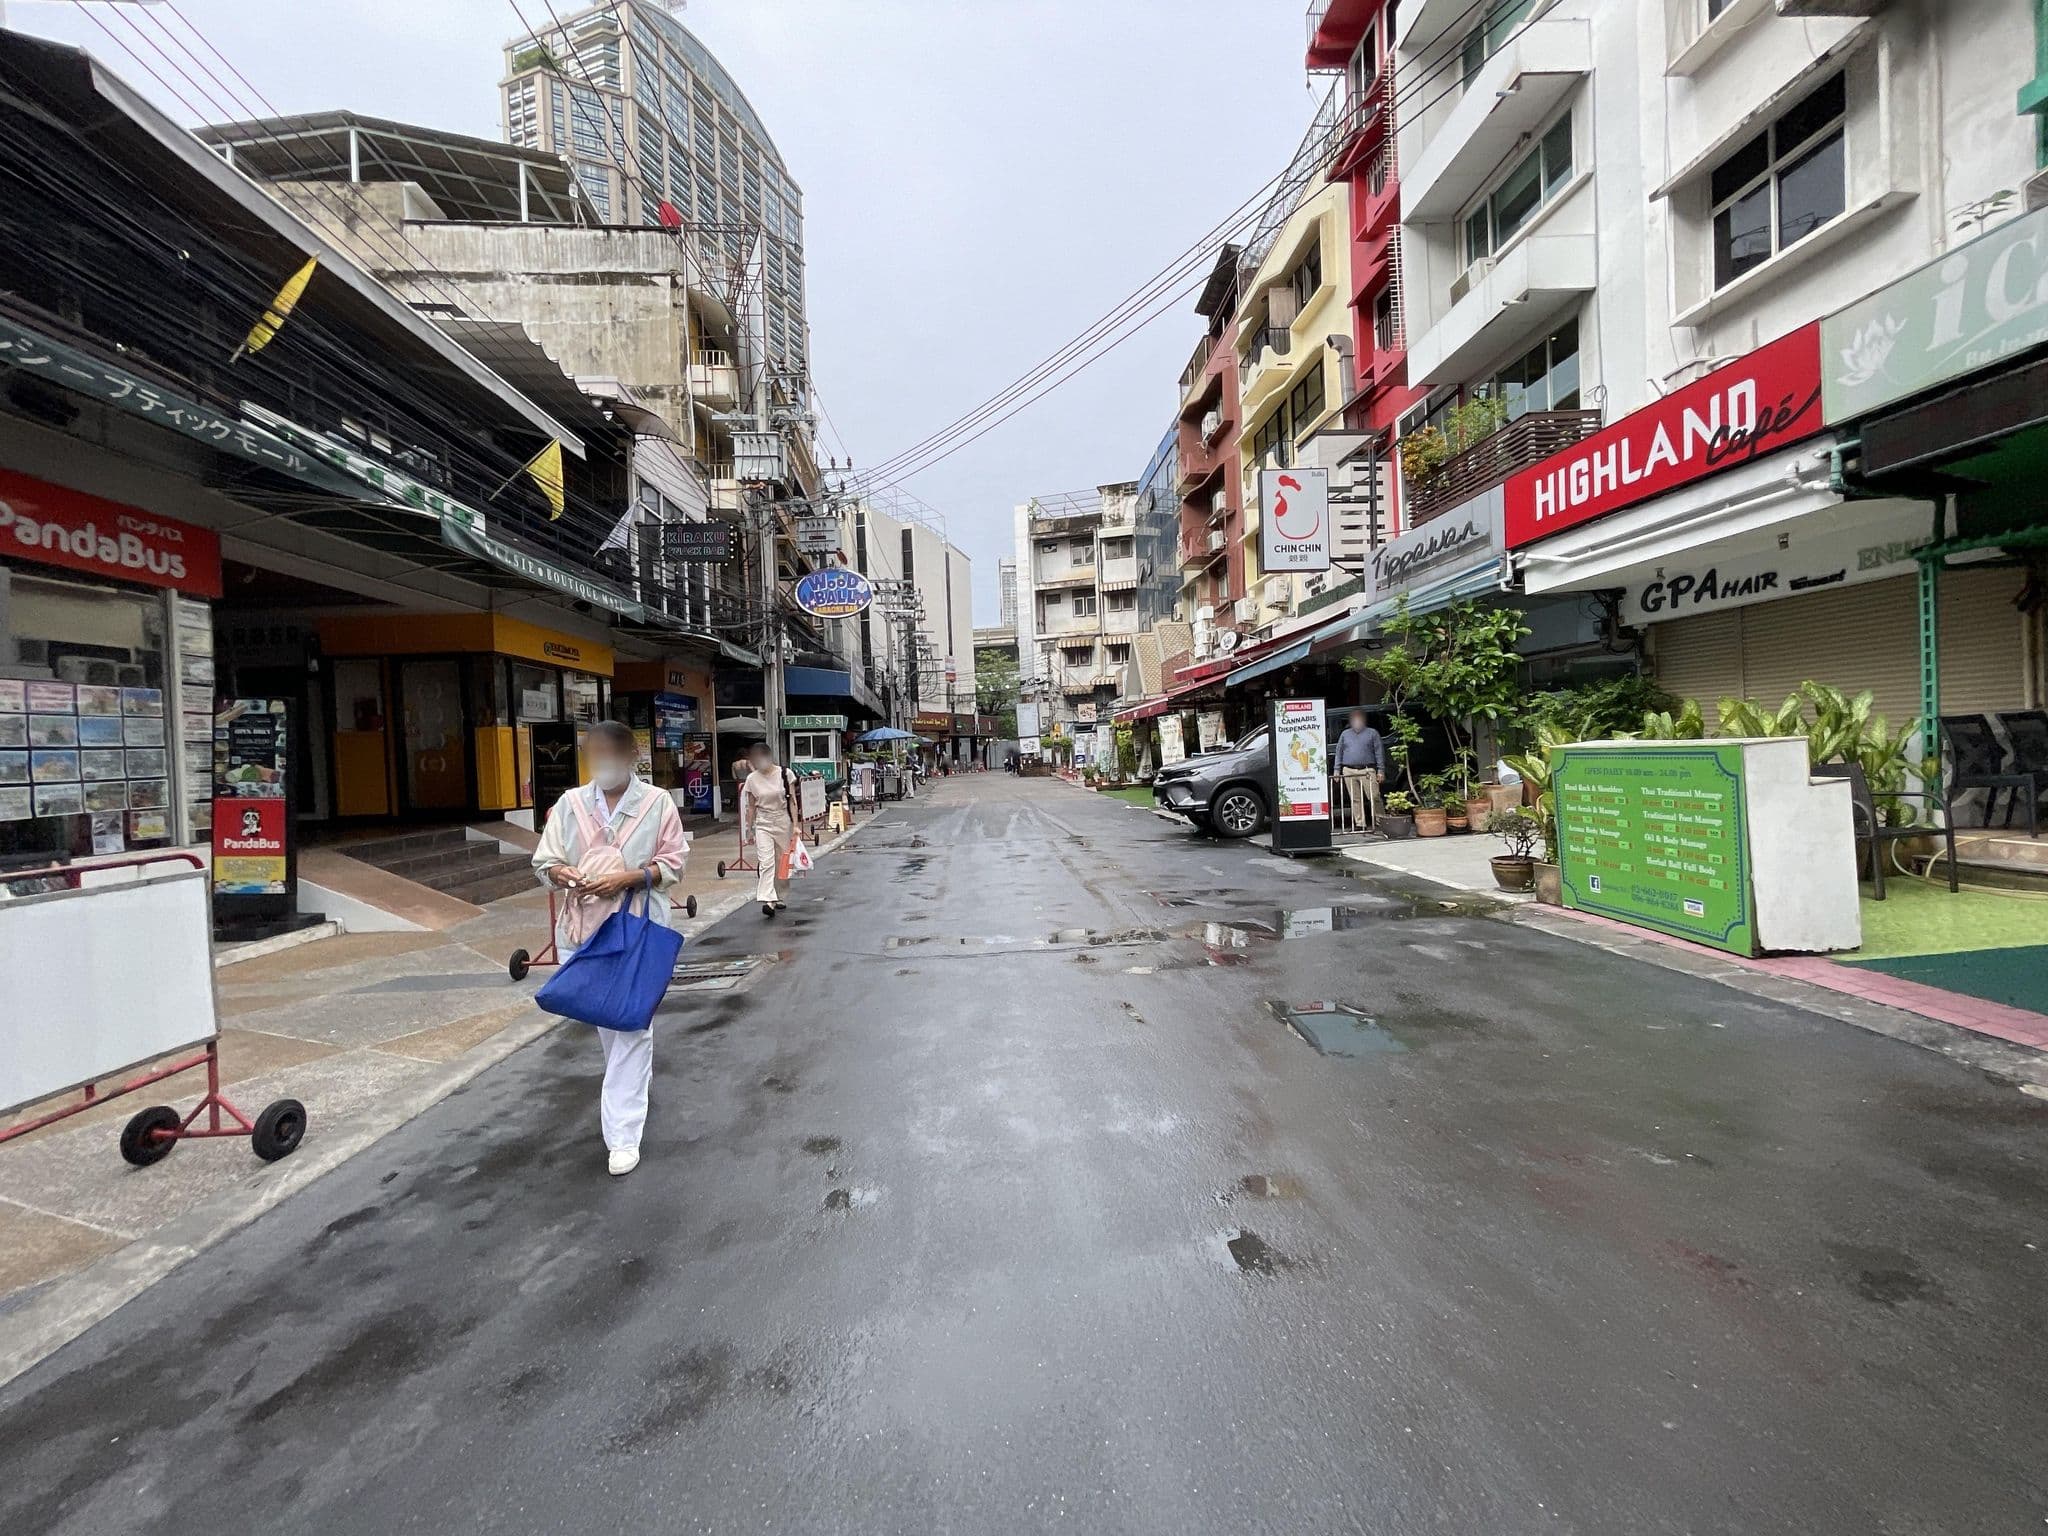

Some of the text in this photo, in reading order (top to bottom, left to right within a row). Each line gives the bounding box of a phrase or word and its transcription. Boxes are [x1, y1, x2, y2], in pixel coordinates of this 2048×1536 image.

[1706, 387, 1823, 467] Café
[1534, 378, 1757, 521] HIGHLAND
[667, 527, 725, 544] KIRAKU
[1274, 543, 1322, 553] CHIN CHIN
[1371, 520, 1479, 589] Tippawan
[547, 568, 599, 601] BOUTIQUE
[1640, 568, 1717, 613] GPA
[1721, 572, 1779, 599] HAIR
[813, 589, 857, 607] BALL
[1278, 724, 1320, 733] DISPENSARY
[1282, 716, 1317, 725] CANNABIS
[1641, 786, 1655, 795] Thai
[224, 838, 280, 850] PandaBus
